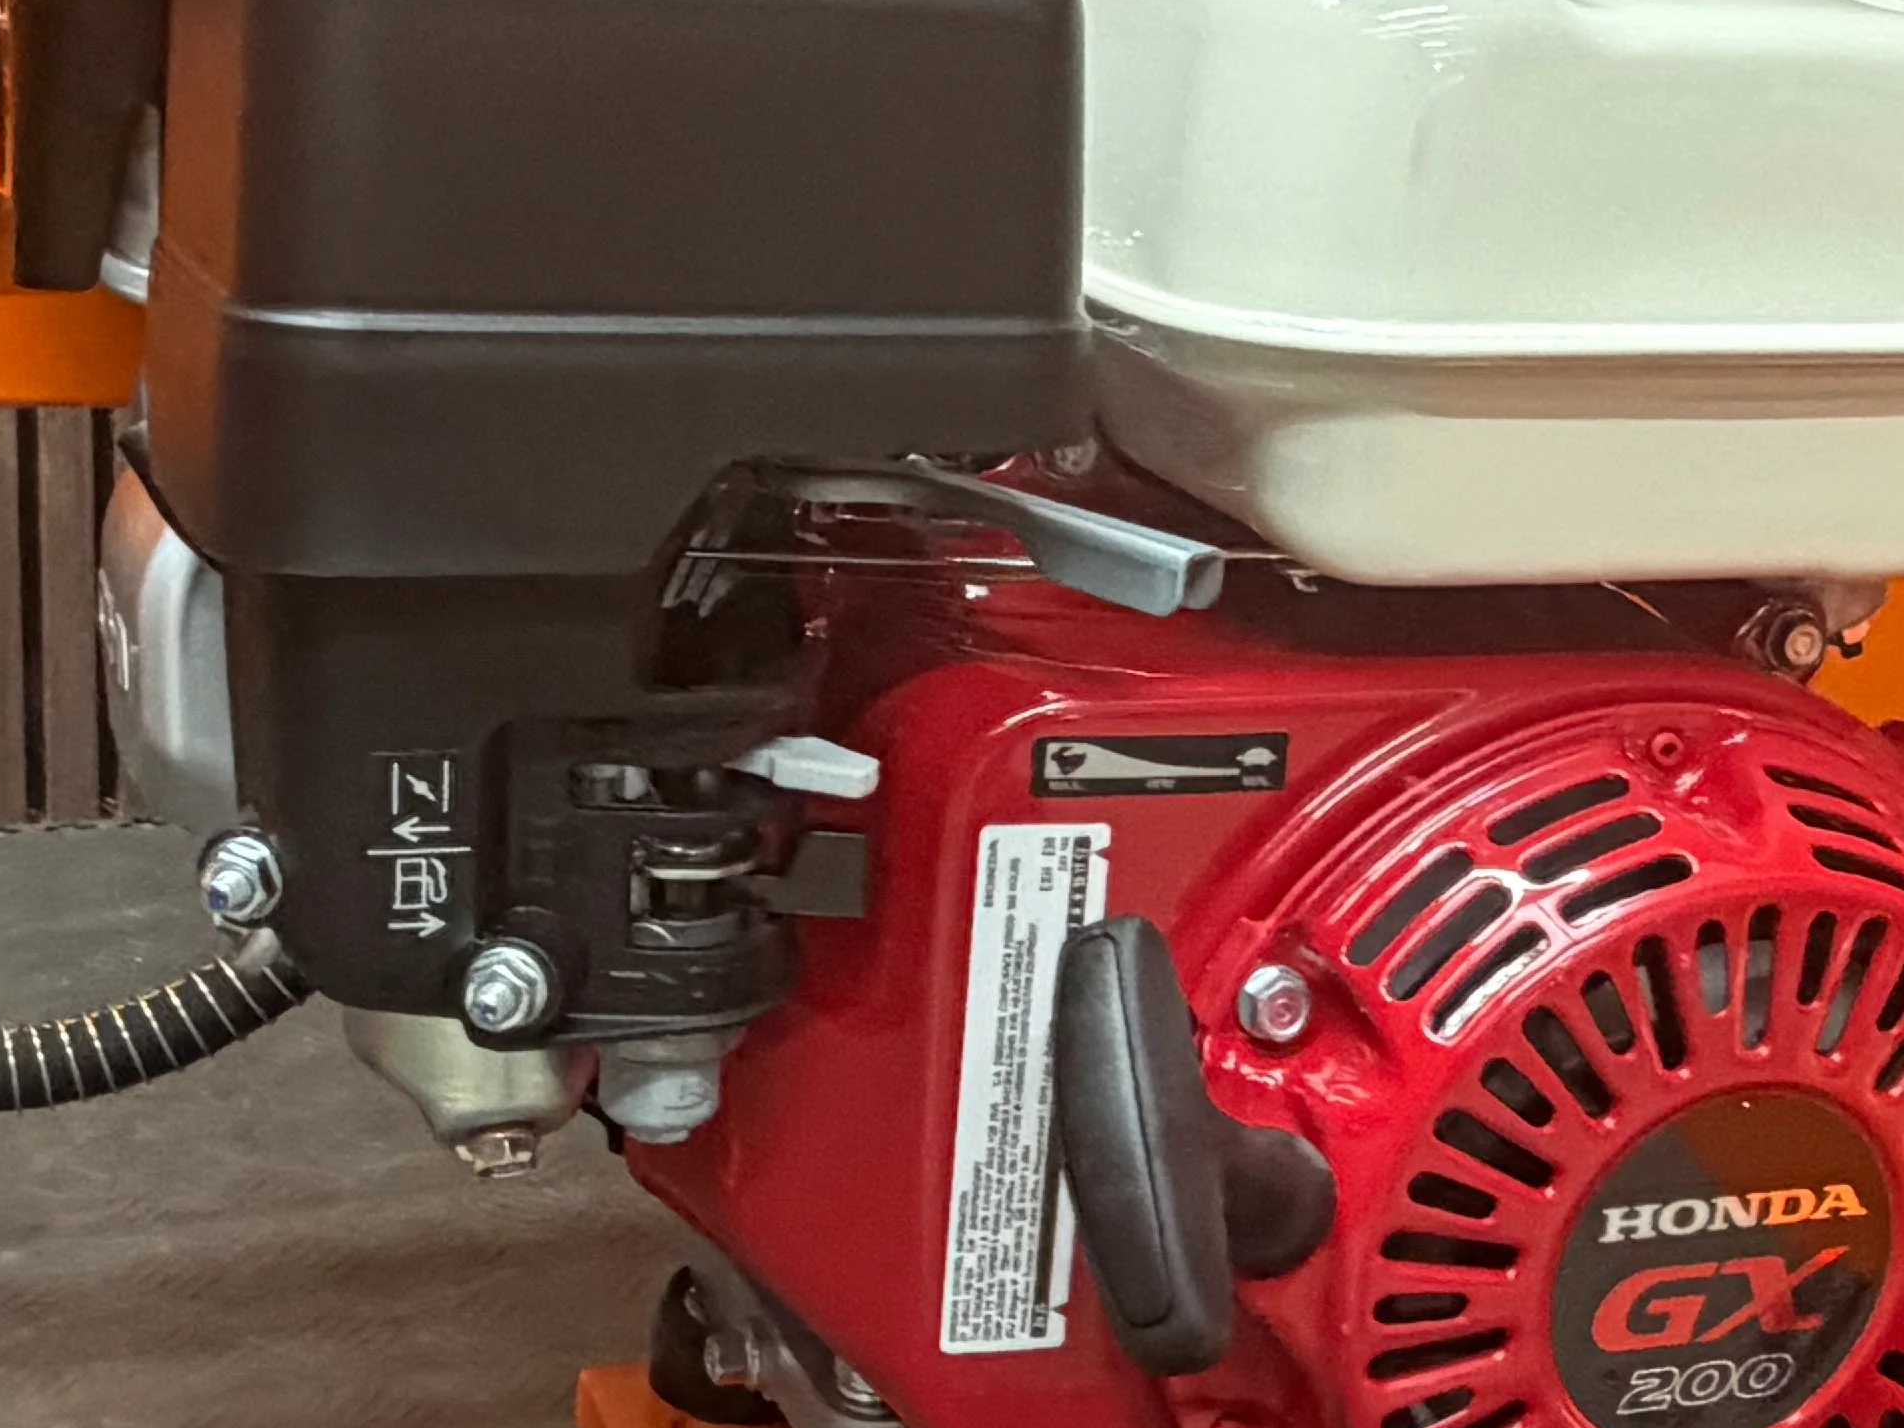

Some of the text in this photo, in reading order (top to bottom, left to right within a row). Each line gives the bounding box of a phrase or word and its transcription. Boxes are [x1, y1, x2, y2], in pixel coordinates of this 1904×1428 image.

[1599, 1184, 1868, 1243] HONDA
[1592, 1245, 1850, 1353] GX
[1616, 1353, 1794, 1415] 200
